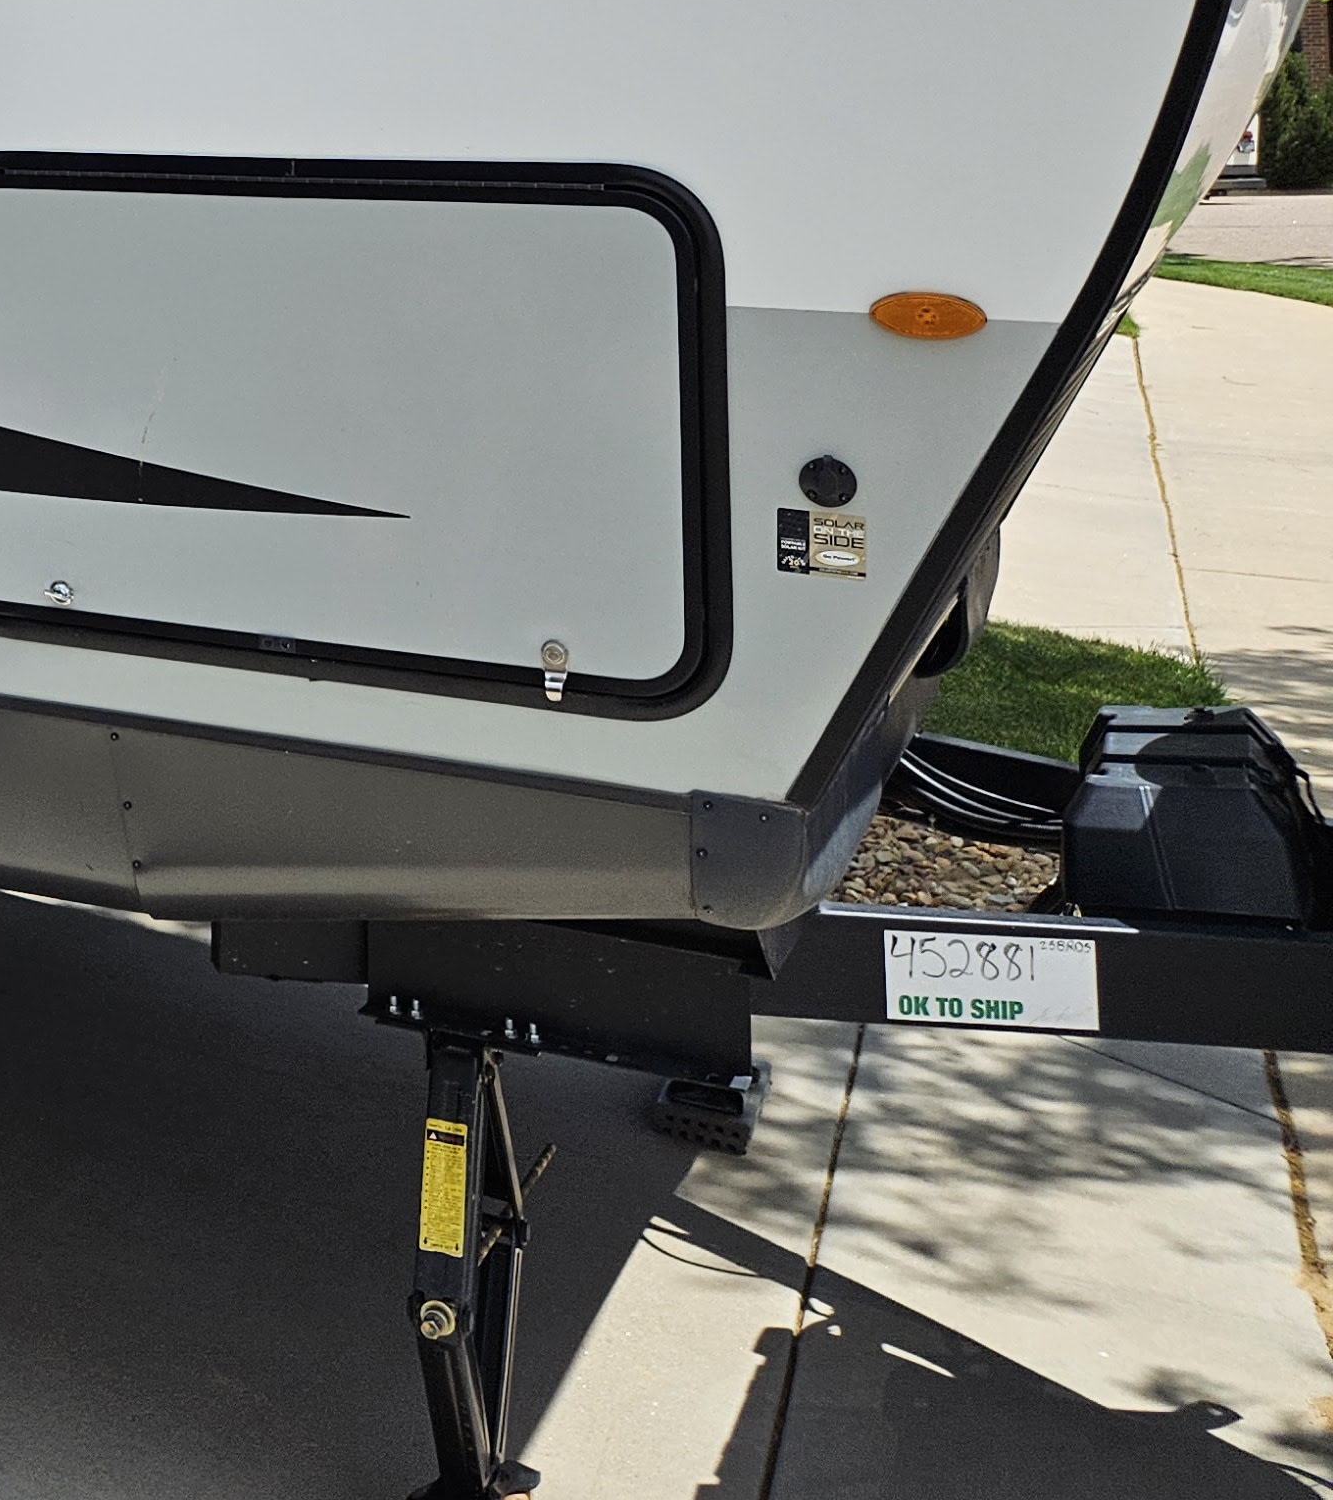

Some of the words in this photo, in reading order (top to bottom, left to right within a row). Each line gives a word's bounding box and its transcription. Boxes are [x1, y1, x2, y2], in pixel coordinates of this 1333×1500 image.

[813, 518, 865, 531] SOLAR
[813, 525, 834, 535] ON
[837, 528, 865, 539] THE
[813, 533, 865, 550] SIDE
[890, 934, 1035, 982] 452881
[898, 994, 930, 1017] OK
[935, 996, 963, 1019] TO
[970, 998, 1024, 1021] SHIP
